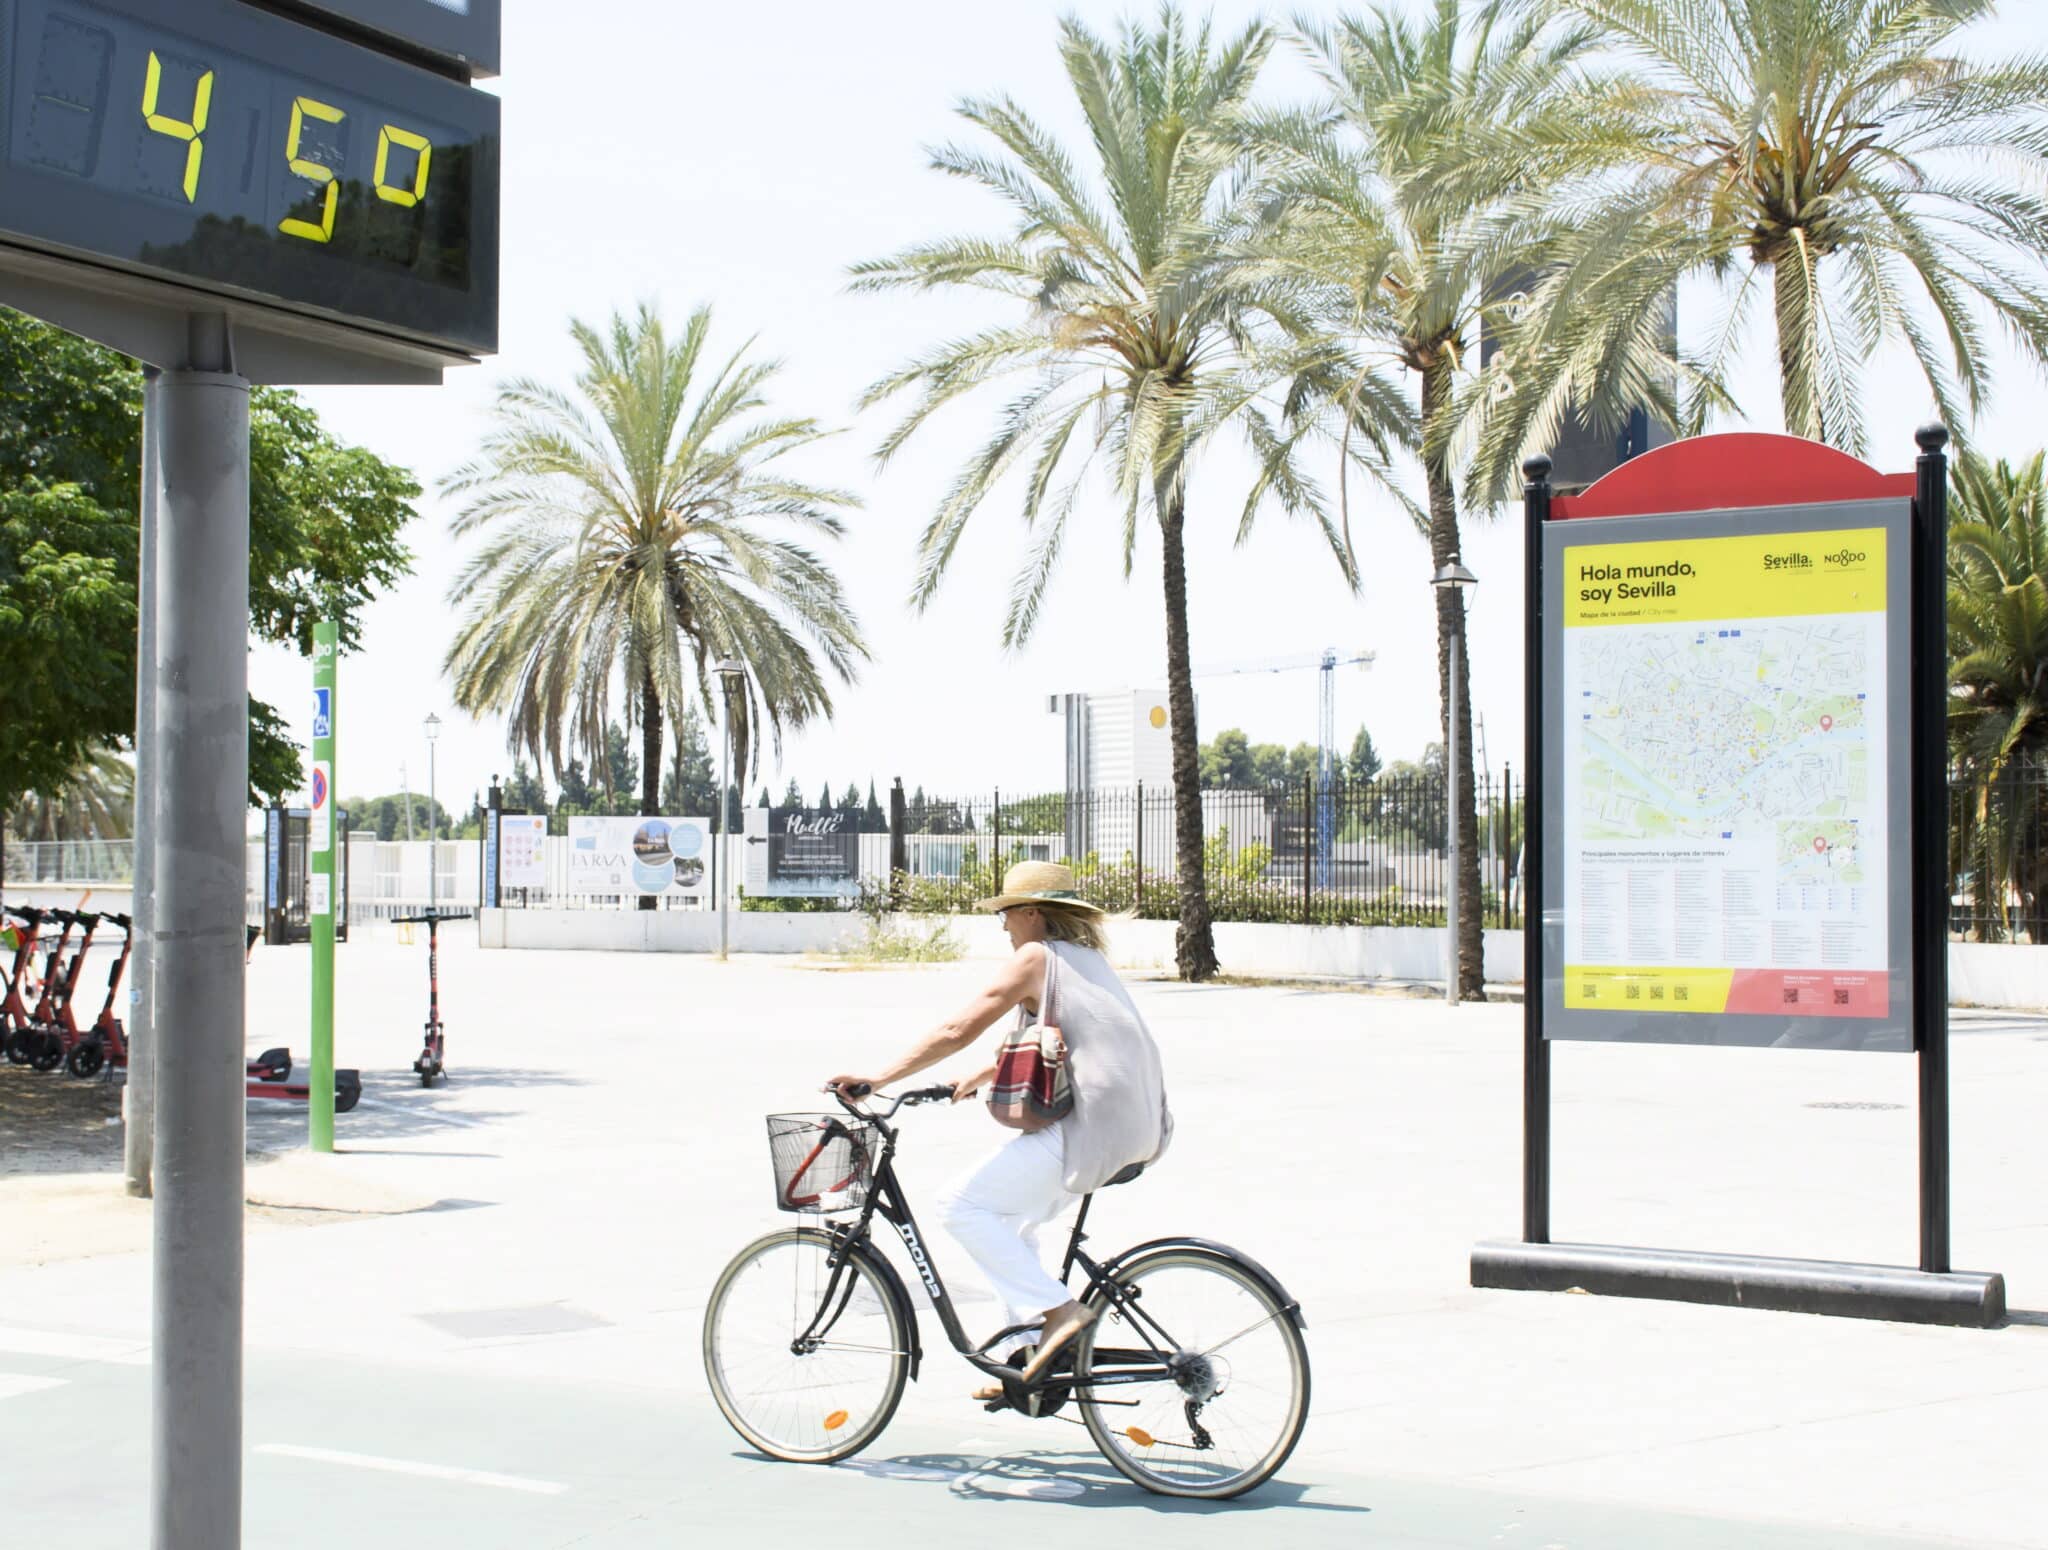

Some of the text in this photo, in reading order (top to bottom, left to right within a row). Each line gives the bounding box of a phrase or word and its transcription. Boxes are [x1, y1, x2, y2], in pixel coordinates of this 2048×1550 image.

[1580, 559, 1696, 581] Hola mundo,
[1580, 581, 1676, 604] soy Sevilla
[786, 814, 839, 835] Muelle
[901, 1224, 941, 1298] moma
